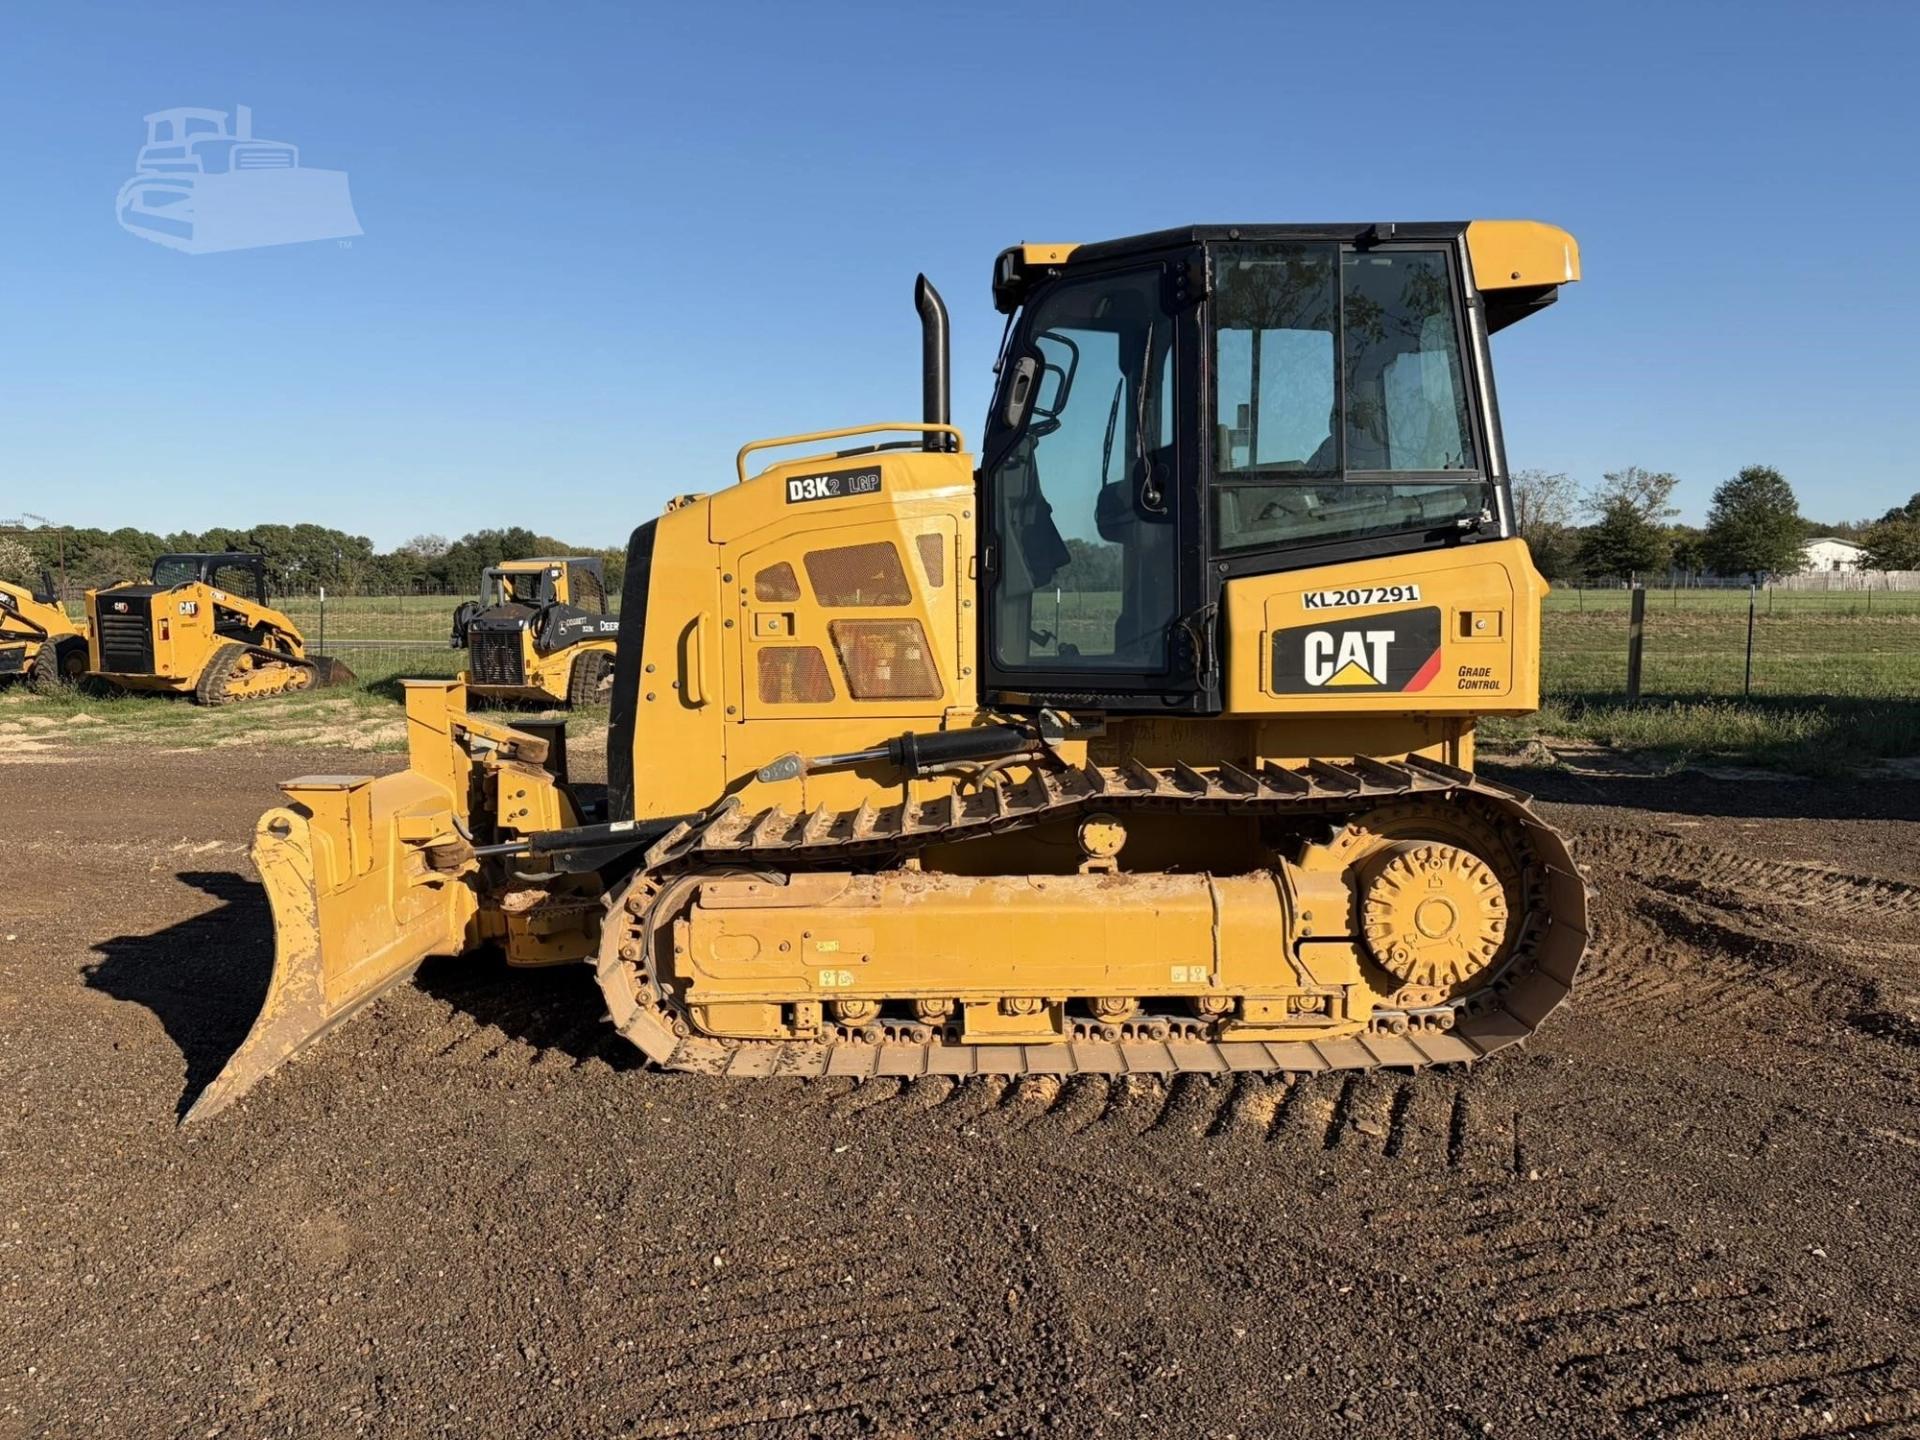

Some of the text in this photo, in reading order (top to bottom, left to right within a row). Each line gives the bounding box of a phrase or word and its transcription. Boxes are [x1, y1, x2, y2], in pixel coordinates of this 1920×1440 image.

[789, 475, 879, 501] D3K2 LGP
[1303, 585, 1419, 609] KL207291
[114, 602, 126, 611] CAT
[179, 601, 197, 616] CAT
[1304, 630, 1396, 687] CAT
[1458, 665, 1492, 677] GRADE
[1457, 678, 1501, 690] CONTROL
